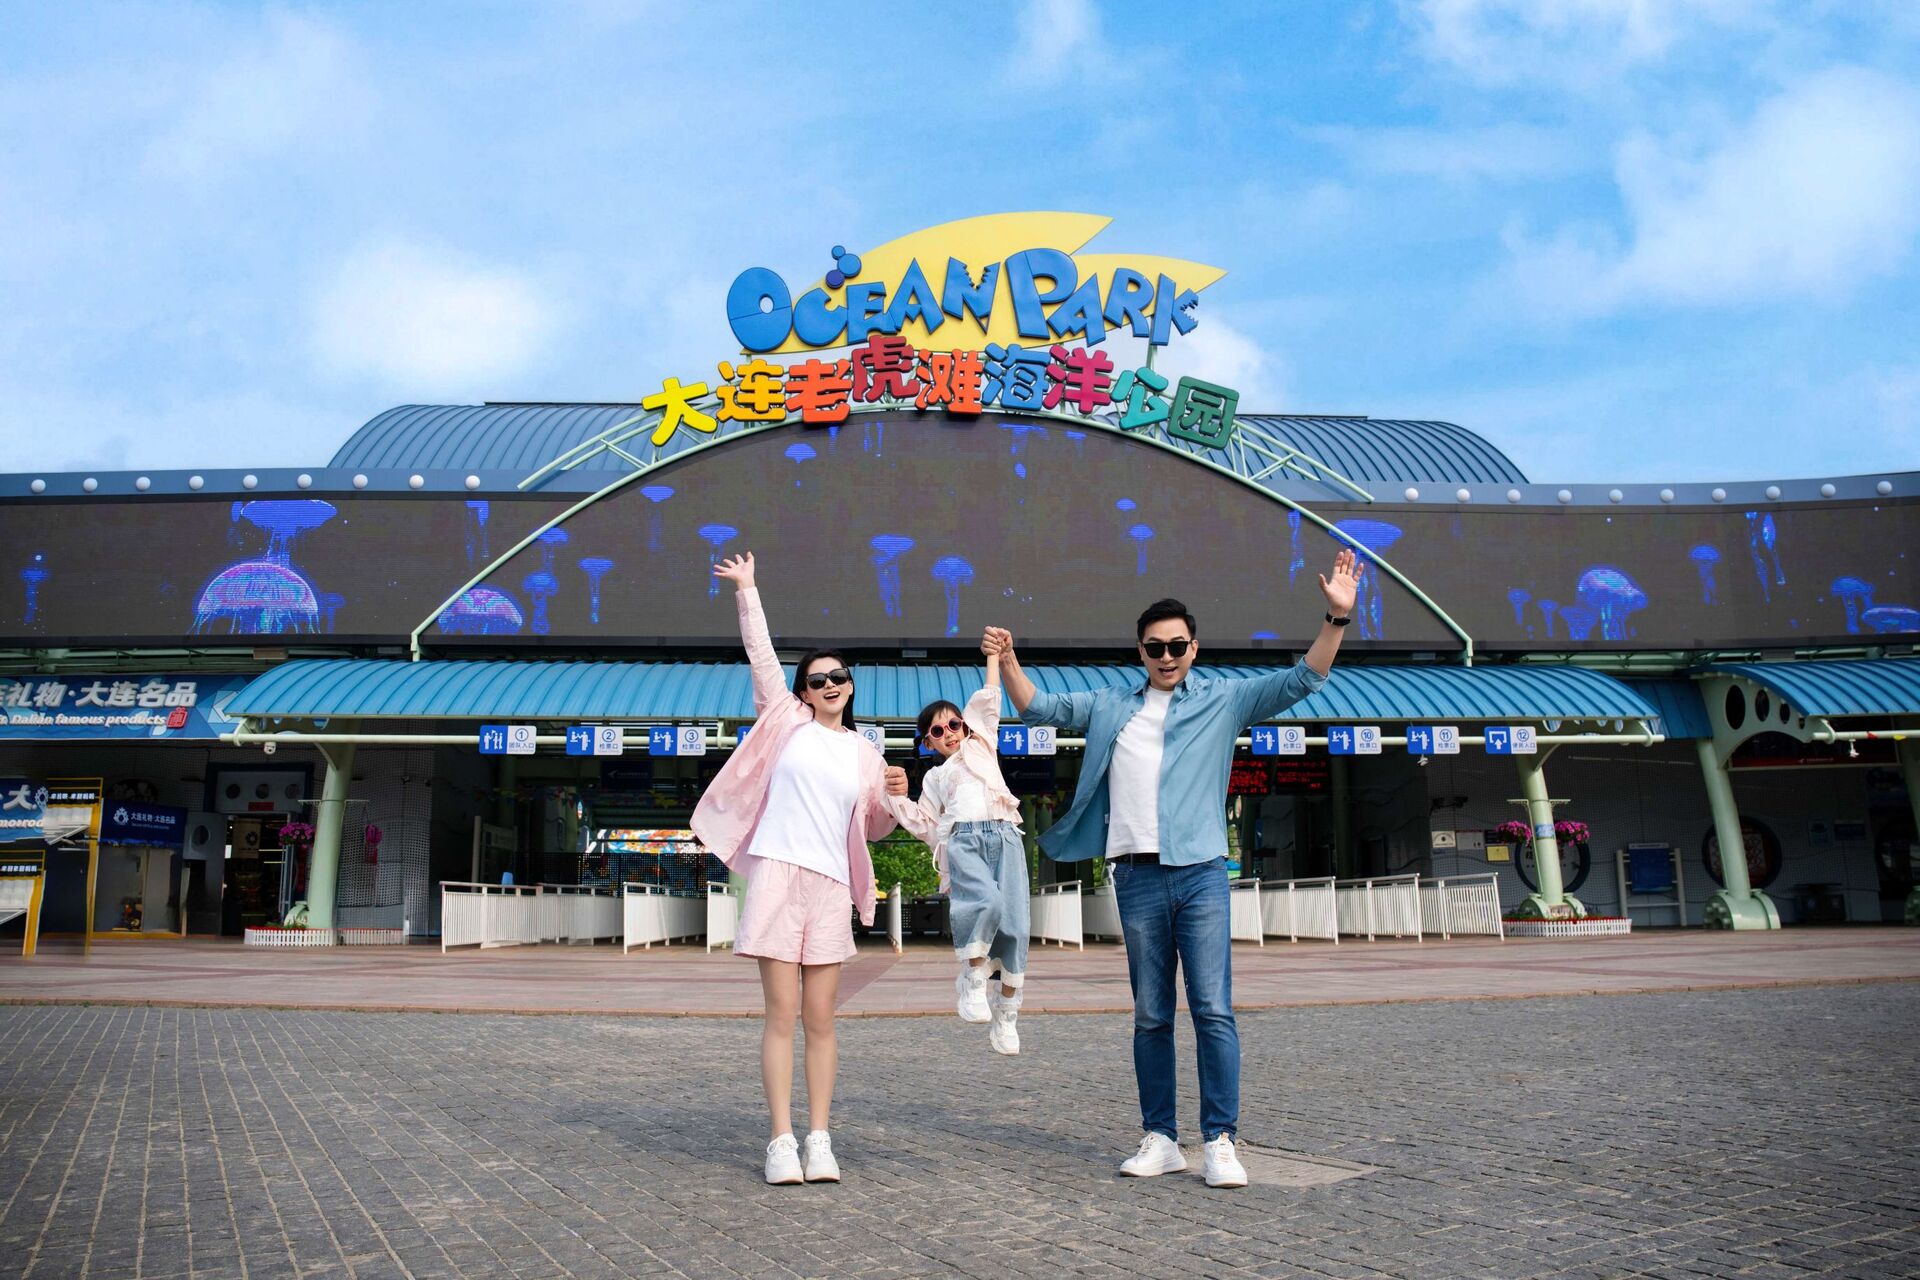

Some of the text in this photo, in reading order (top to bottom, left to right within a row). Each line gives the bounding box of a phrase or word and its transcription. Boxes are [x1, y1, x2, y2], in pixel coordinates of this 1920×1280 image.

[726, 247, 1200, 353] OCEAN PARK
[641, 334, 1240, 450] 大连老虎滩海洋公园
[55, 713, 105, 725] famous
[105, 713, 167, 727] products
